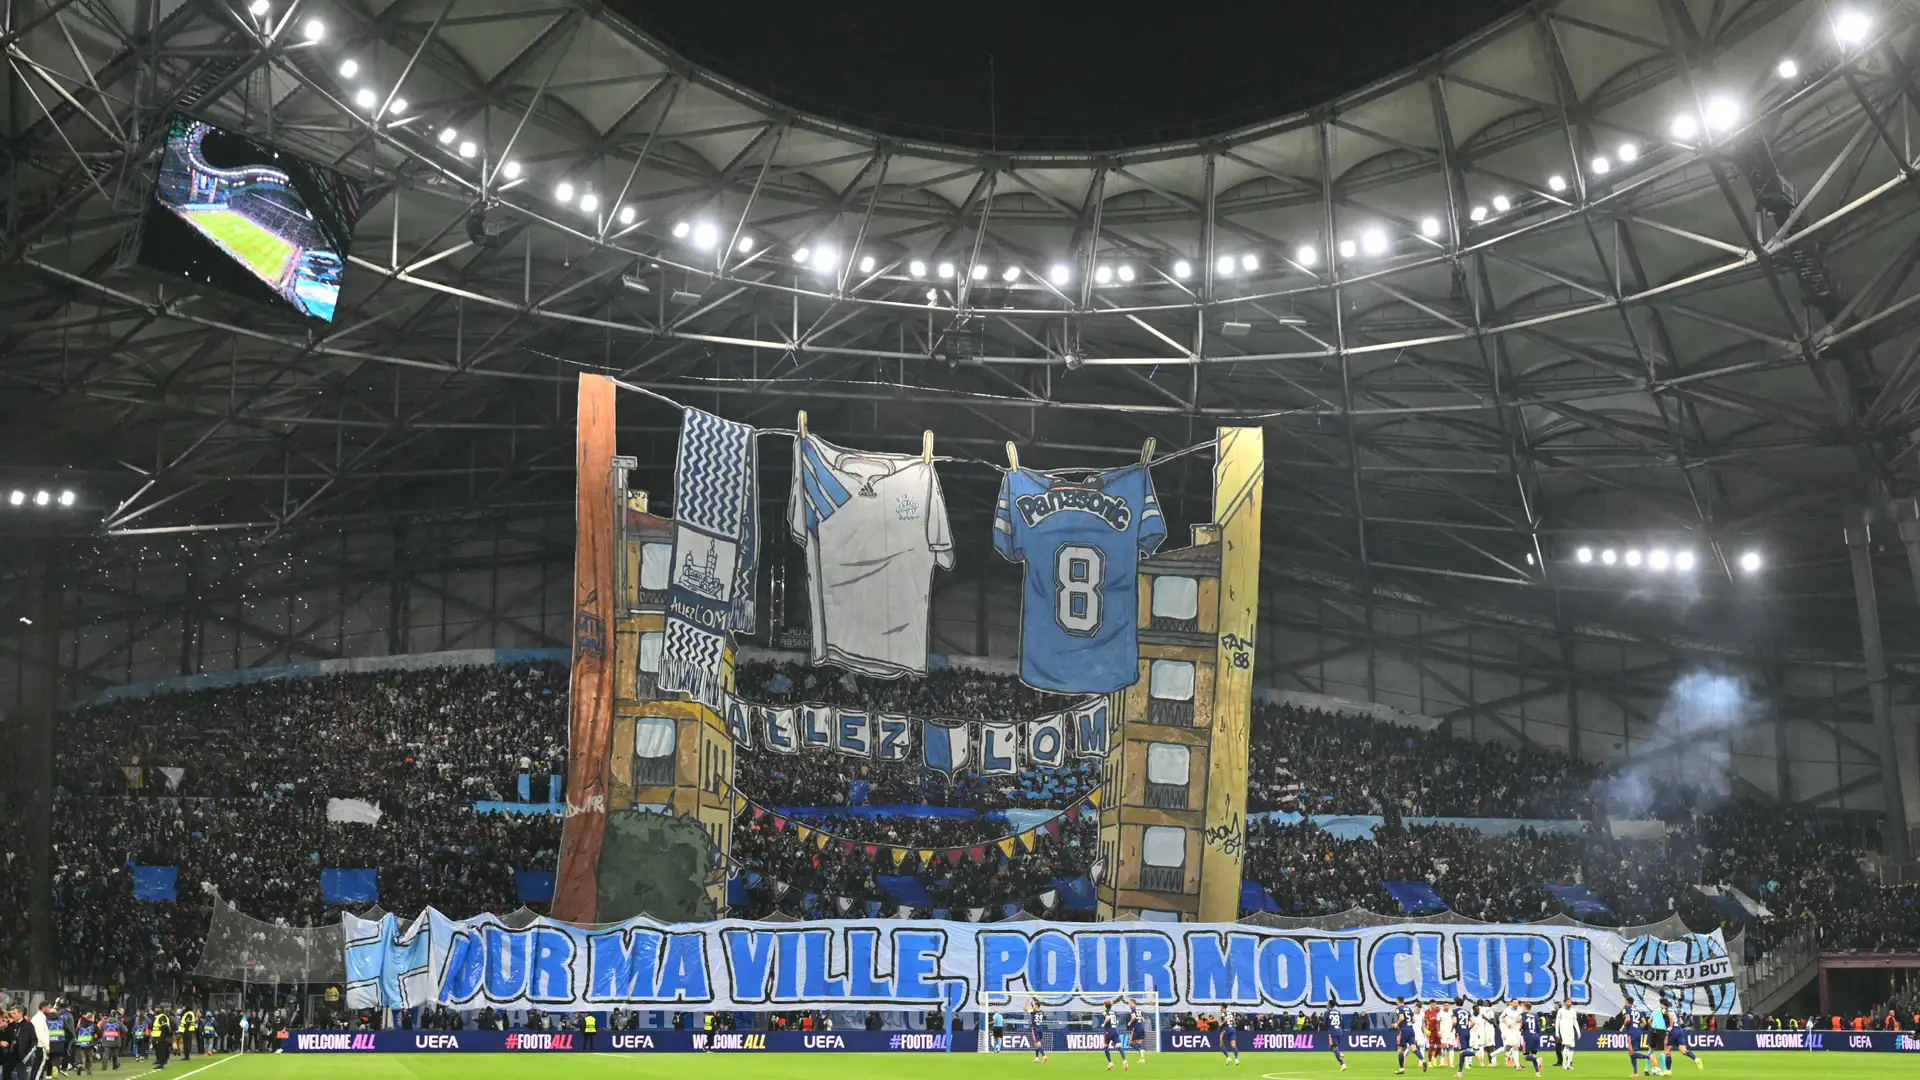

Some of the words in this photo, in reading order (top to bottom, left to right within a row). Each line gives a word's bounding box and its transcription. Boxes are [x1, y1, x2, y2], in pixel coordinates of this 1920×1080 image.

[1015, 491, 1132, 532] Panasonic
[1054, 541, 1106, 638] 8
[1221, 624, 1253, 651] FAN
[1233, 652, 1250, 669] 88
[728, 703, 907, 760] ALLEZ
[986, 706, 1108, 771] L'OM
[583, 924, 715, 1004] MA
[719, 927, 969, 1012] VILLE,
[975, 928, 1179, 1007] POUR
[1185, 930, 1365, 1008] MON
[1367, 930, 1557, 1006] CLUB
[1561, 935, 1592, 1005] !
[1673, 968, 1695, 980] AU
[1699, 961, 1728, 977] BUT
[1329, 1014, 1340, 1026] 28
[1405, 1010, 1411, 1022] 5
[1458, 1012, 1469, 1024] 21
[1631, 1010, 1640, 1023] 12
[1526, 1017, 1536, 1032] 11
[298, 1034, 350, 1049] WELCOME
[352, 1034, 375, 1049] ALL
[416, 1035, 459, 1048] UEFA
[505, 1034, 573, 1049] #FOOTBALL
[612, 1035, 654, 1048] UEFA
[693, 1034, 743, 1049] WCOME
[744, 1034, 766, 1049] ALL
[804, 1035, 845, 1048] UEFA
[889, 1034, 952, 1049] #FOOTBAL
[1172, 1035, 1211, 1048] UEFA
[1253, 1034, 1314, 1048] #FOOTBALL
[1348, 1035, 1387, 1048] UEFA
[1687, 1035, 1724, 1047] UEFA
[1756, 1034, 1803, 1048] WELCOME
[1804, 1034, 1824, 1048] ALL
[1850, 1035, 1872, 1048] UEFA
